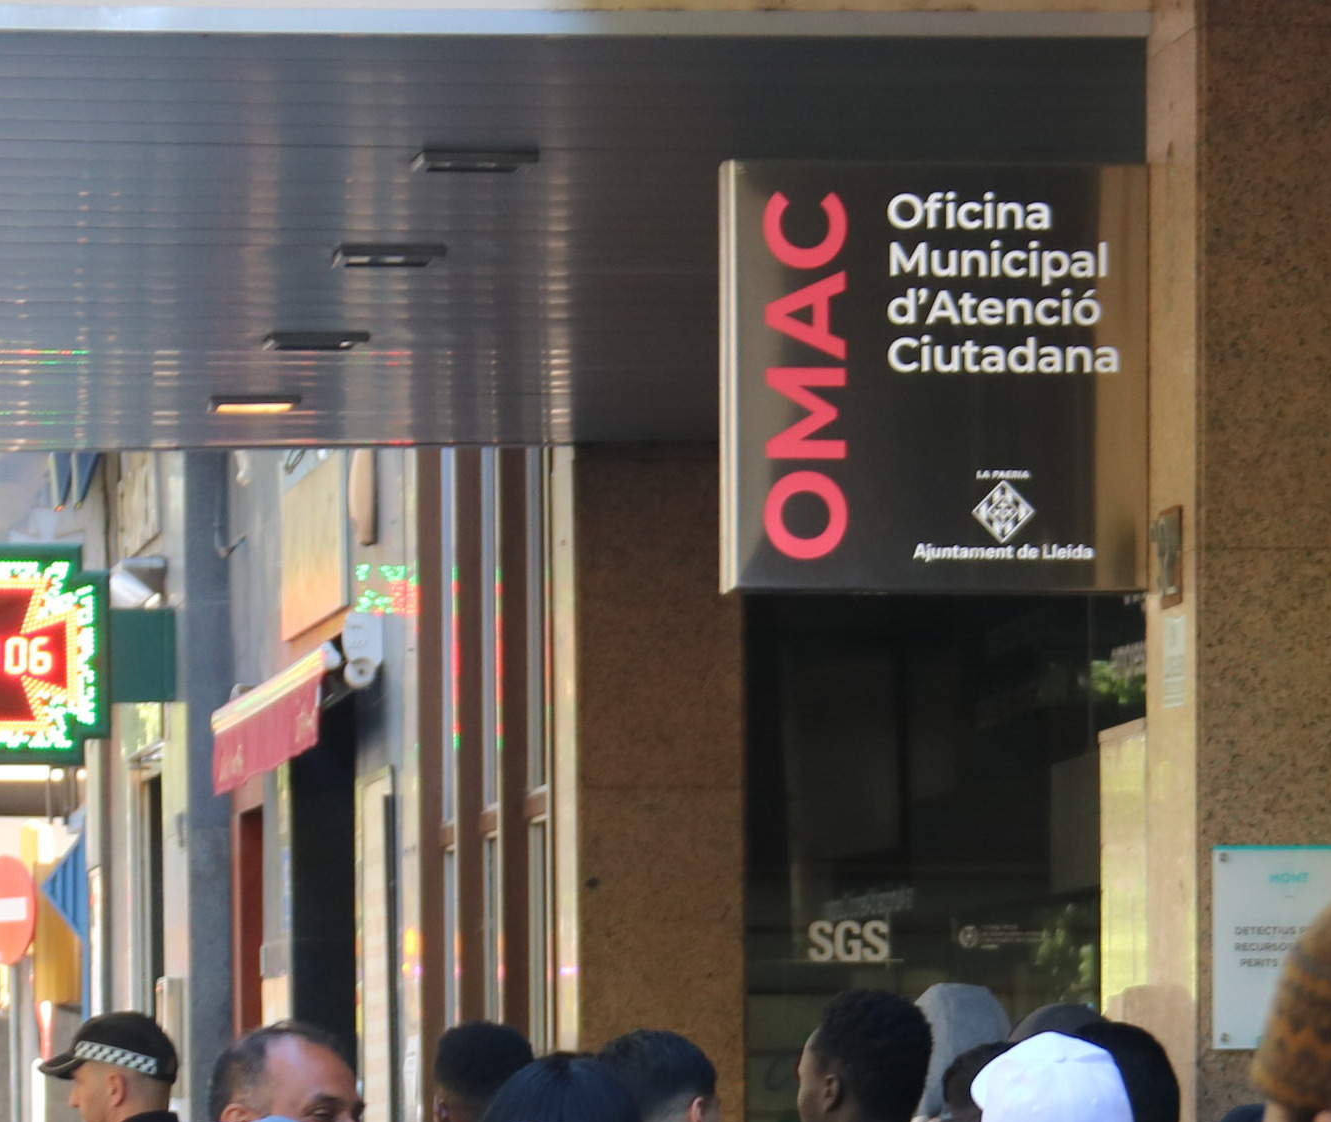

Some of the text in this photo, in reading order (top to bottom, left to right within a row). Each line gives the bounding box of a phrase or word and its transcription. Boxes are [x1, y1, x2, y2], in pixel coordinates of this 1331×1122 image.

[886, 190, 1052, 230] Oficina
[887, 240, 1109, 286] Municipal
[886, 288, 1102, 326] d'Atenció
[886, 335, 1121, 374] Ciutadana
[763, 190, 849, 561] OMAC
[975, 469, 990, 480] LA
[912, 542, 1095, 562] Ajuntament de Lleida
[807, 919, 890, 963] SGS
[1233, 925, 1297, 936] DETECTIUS
[1239, 958, 1279, 968] PERITS
